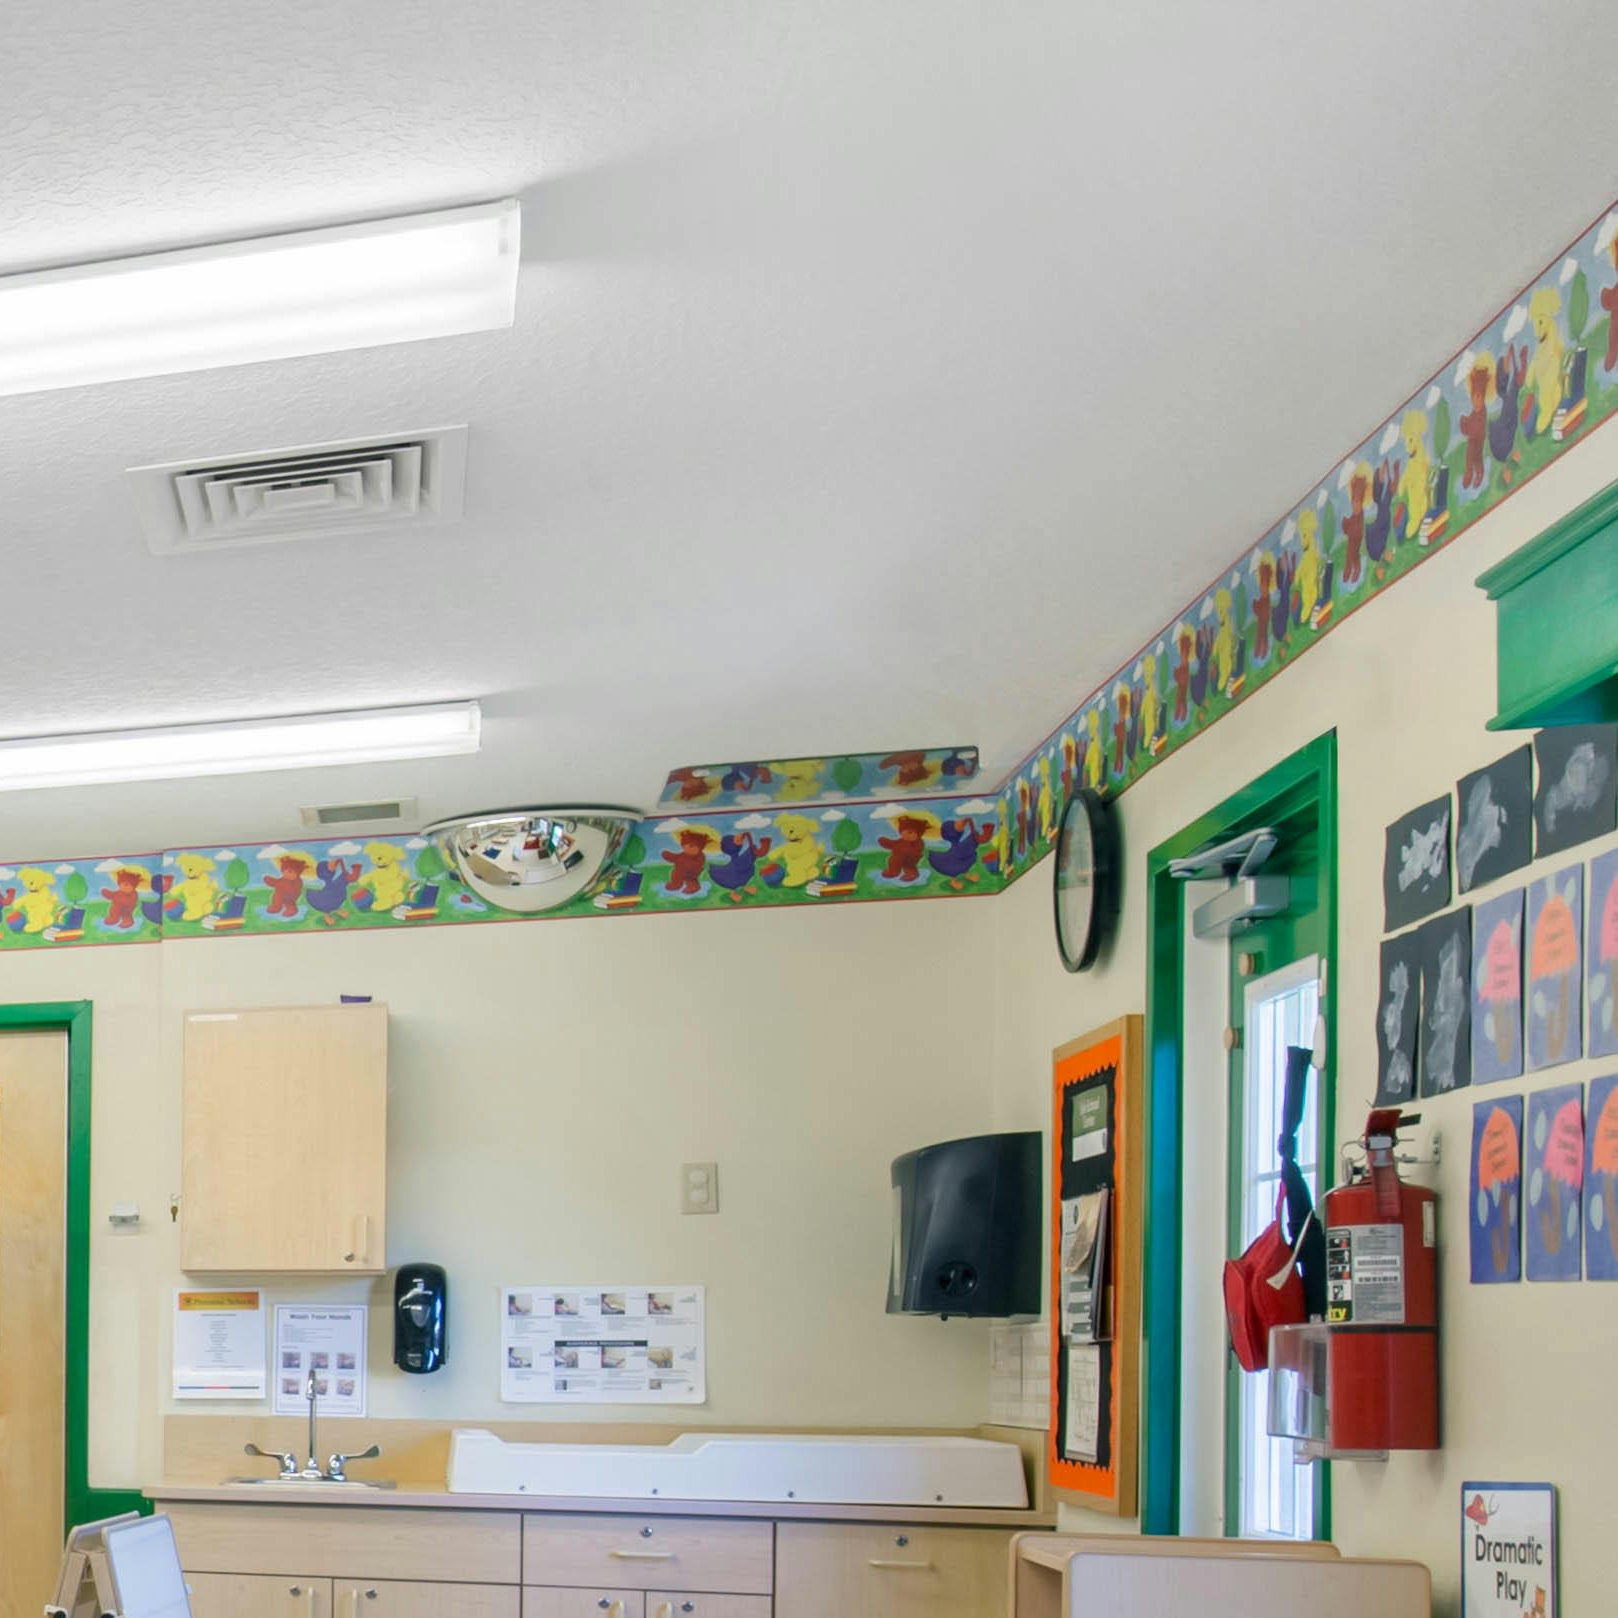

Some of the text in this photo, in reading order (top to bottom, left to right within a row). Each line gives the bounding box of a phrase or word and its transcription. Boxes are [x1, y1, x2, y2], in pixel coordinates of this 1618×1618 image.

[290, 1313, 352, 1321] Wash Your Hands
[1475, 1531, 1543, 1566] Dramatic
[1496, 1570, 1527, 1609] Play
